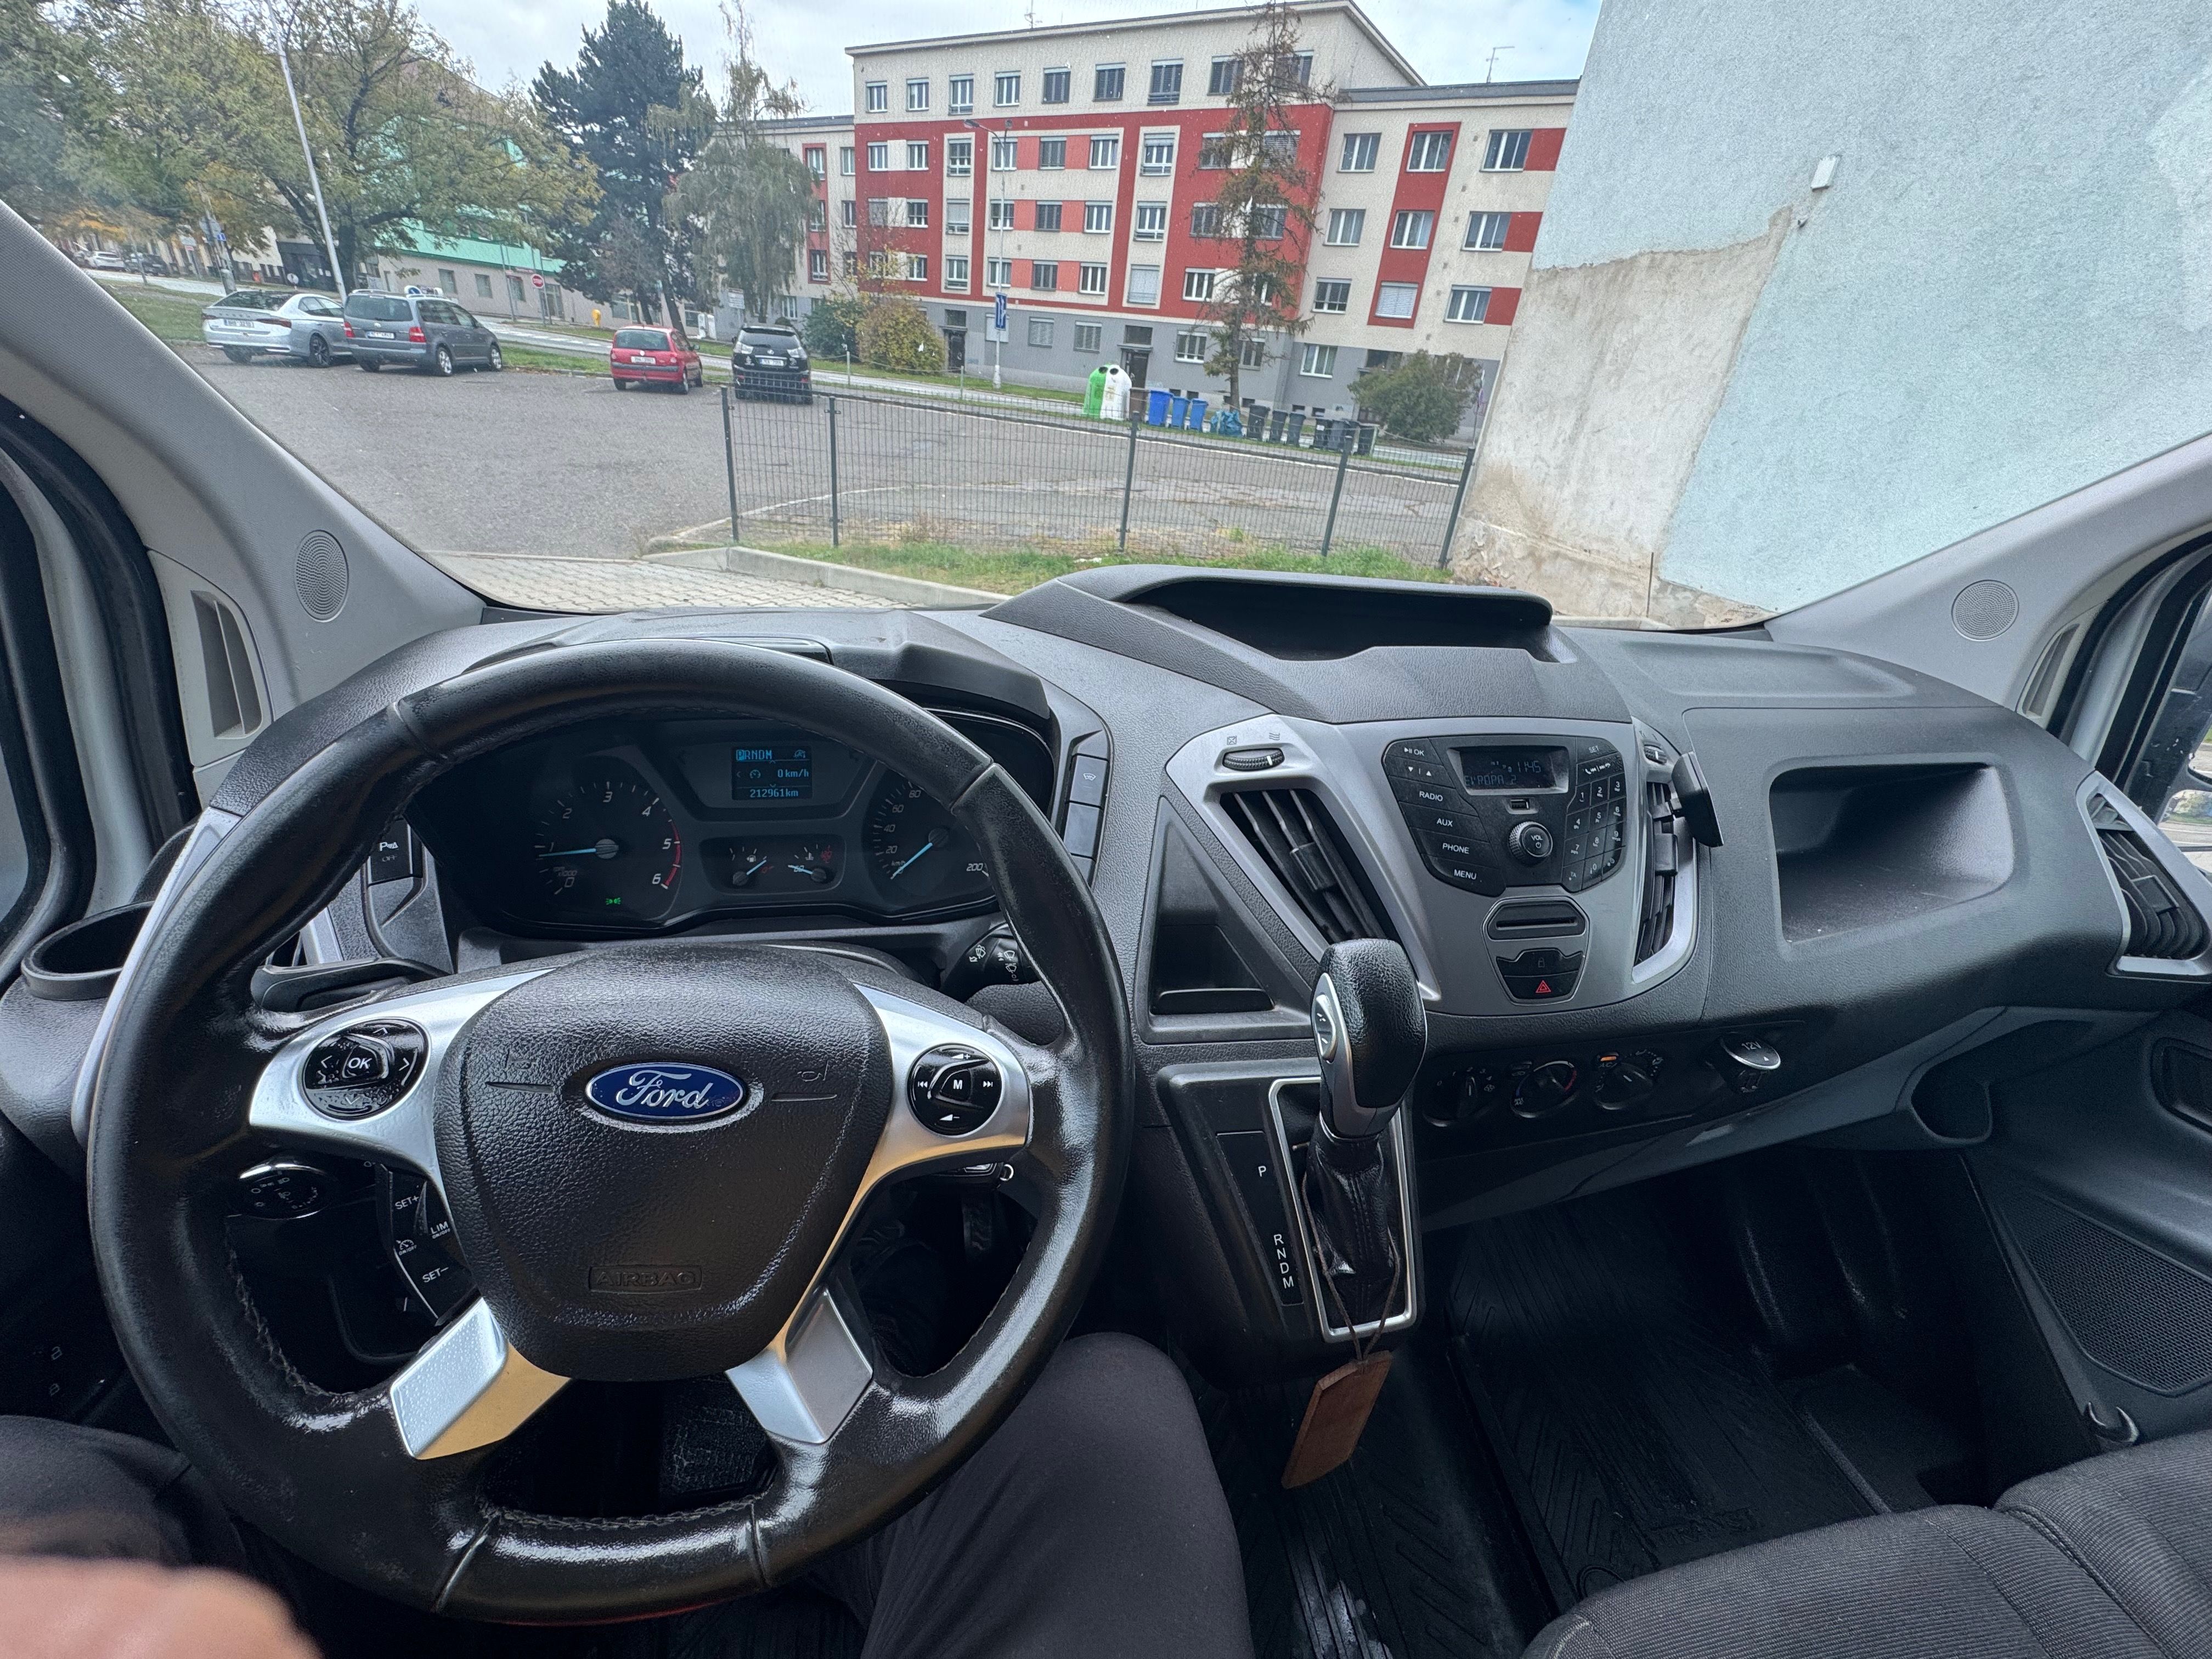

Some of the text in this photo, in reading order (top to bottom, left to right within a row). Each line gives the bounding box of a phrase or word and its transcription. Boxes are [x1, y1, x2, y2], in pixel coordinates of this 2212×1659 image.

[1414, 748, 1425, 757] OK
[1588, 745, 1599, 753] SET
[786, 769, 809, 777] km/h
[1509, 775, 1516, 785] 2
[603, 791, 613, 803] 3
[909, 790, 921, 798] 80
[1419, 791, 1443, 802] RADIO
[562, 808, 572, 819] 2
[642, 806, 651, 817] 4
[892, 804, 904, 813] 60
[1436, 817, 1453, 827] AUX
[883, 824, 895, 833] 40
[662, 838, 672, 850] 5
[885, 845, 898, 854] 20
[1442, 843, 1470, 855] PHONE
[966, 862, 983, 871] 200
[652, 873, 661, 884] 6
[1454, 868, 1477, 880] MENU
[564, 877, 574, 888] 0
[1741, 1041, 1762, 1051] 12V
[348, 1057, 373, 1069] OK
[616, 1069, 714, 1109] Ford
[953, 1079, 963, 1090] M
[1258, 1165, 1267, 1177] P
[430, 1221, 449, 1234] LIM
[1273, 1233, 1284, 1246] R
[1277, 1247, 1286, 1260] N
[1279, 1262, 1289, 1274] D
[596, 1270, 696, 1286] AIRBAG
[1283, 1276, 1294, 1289] M
